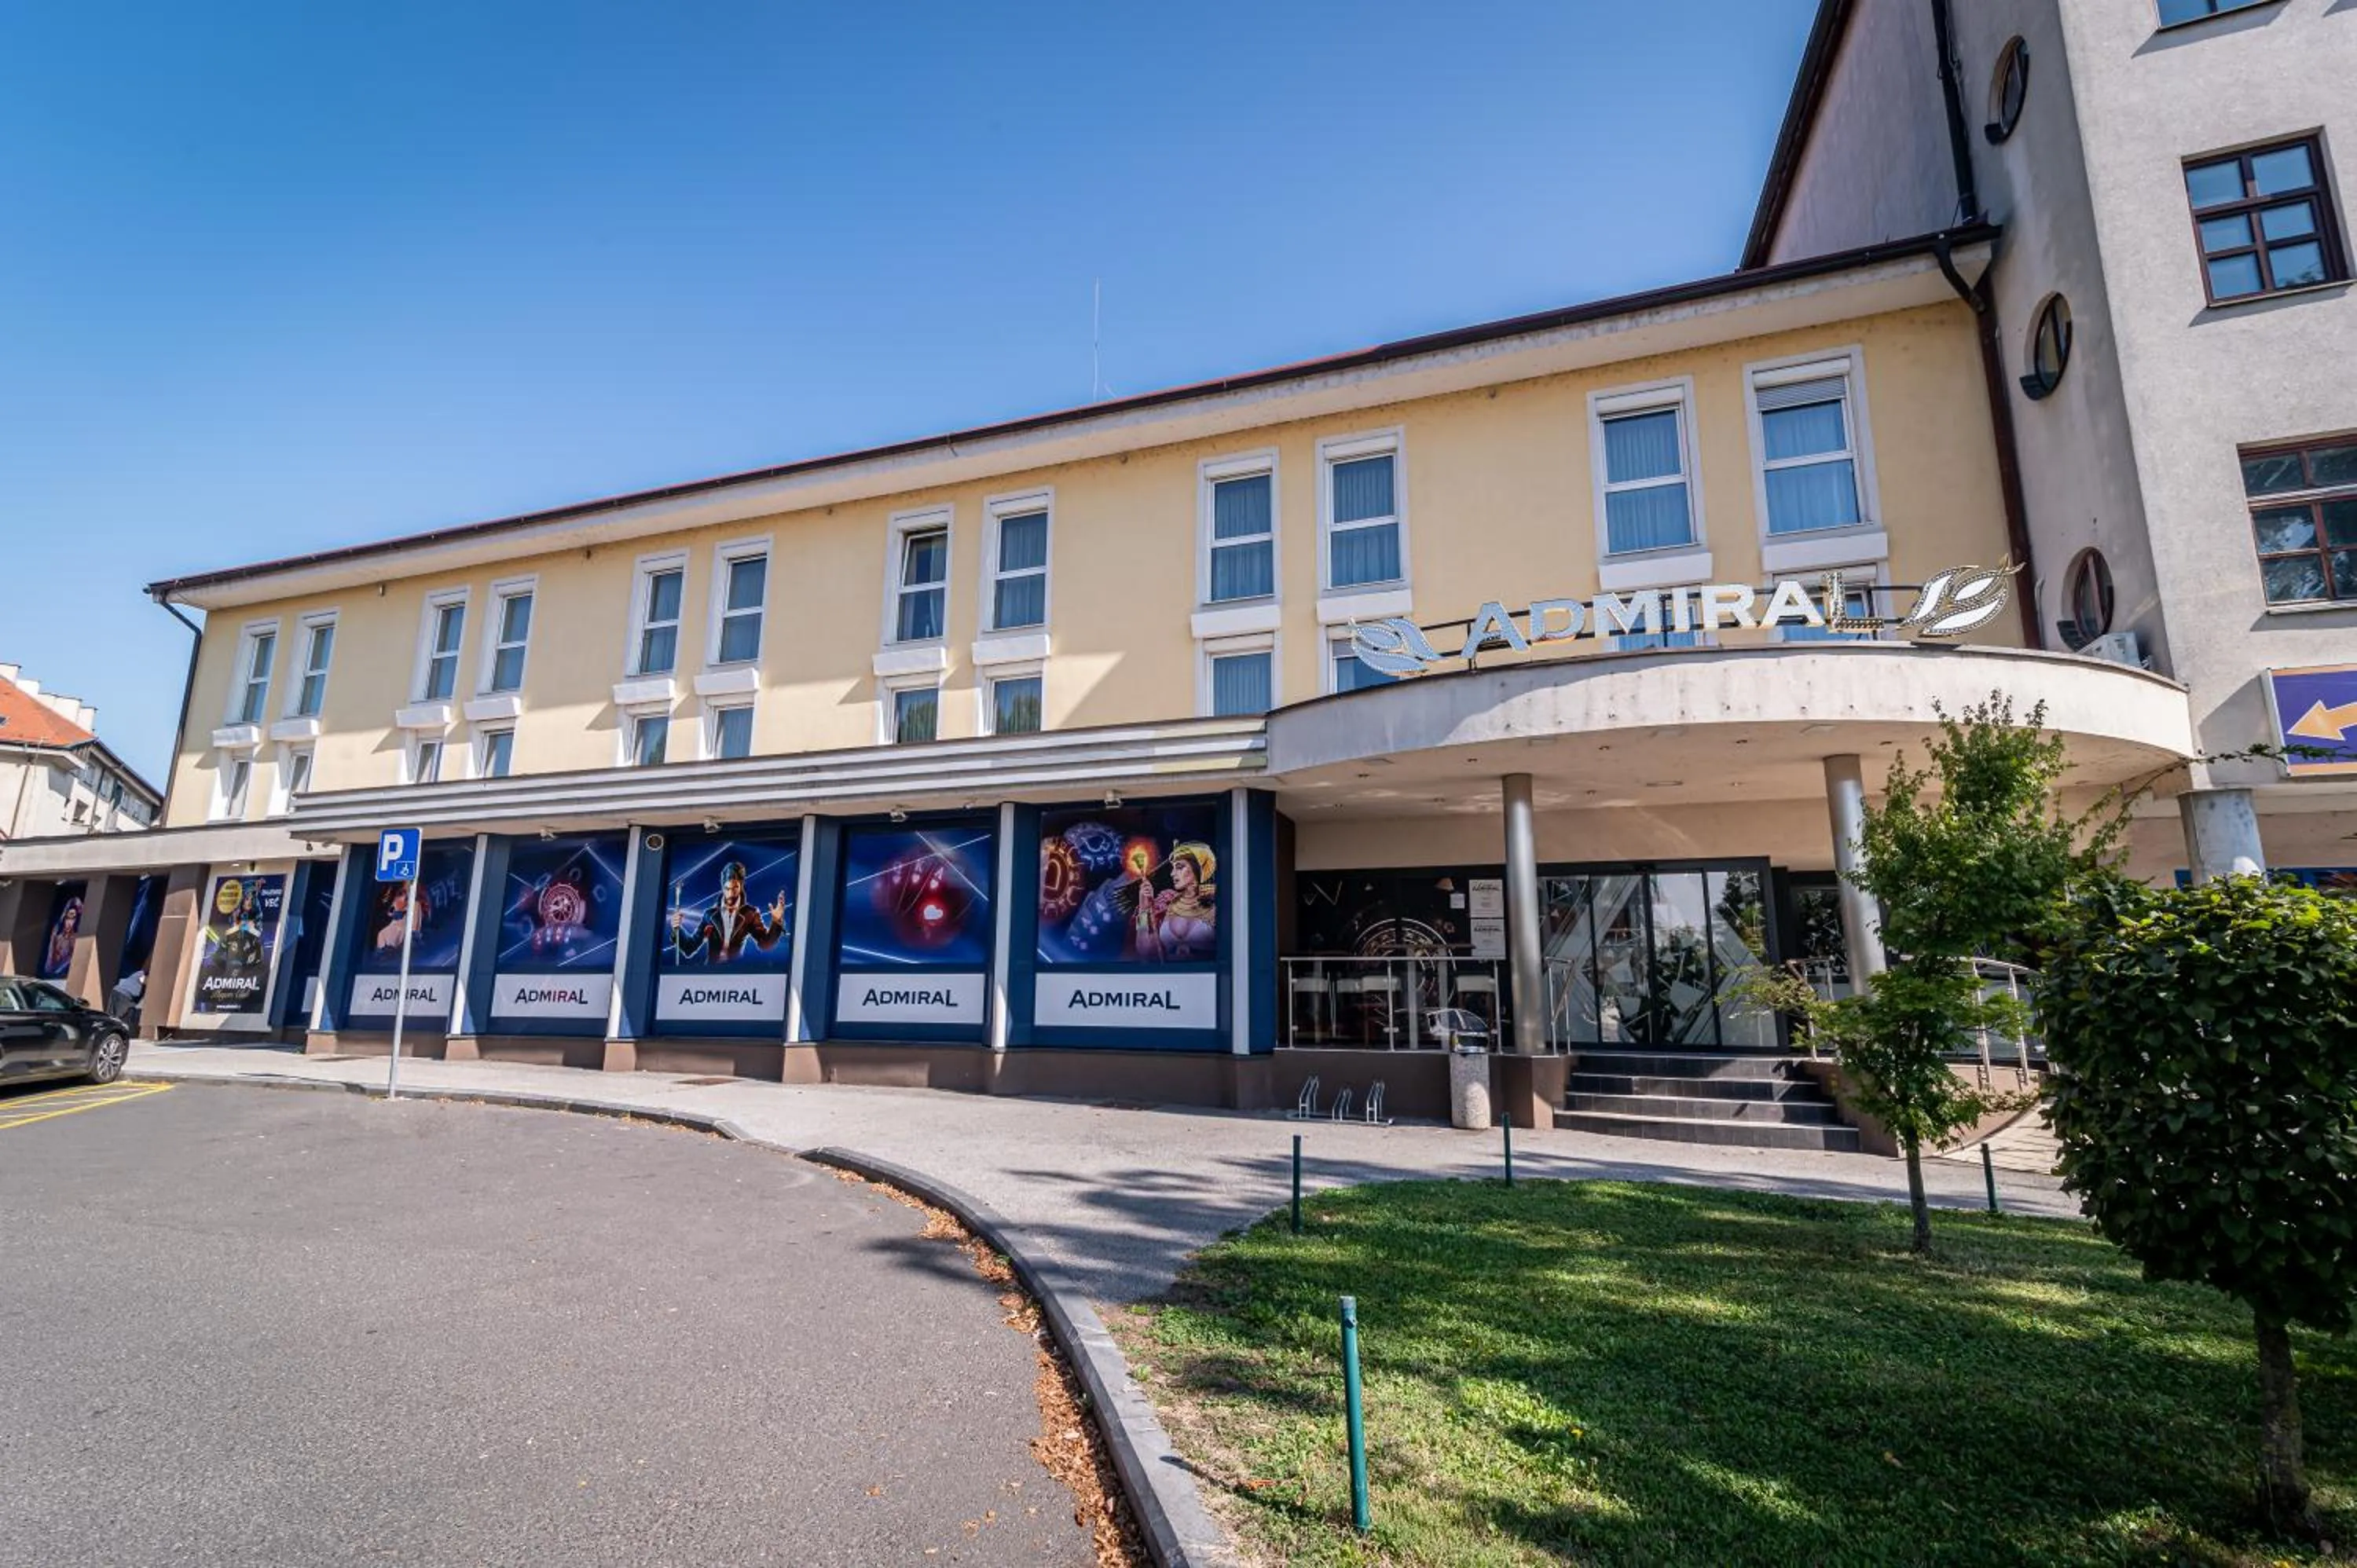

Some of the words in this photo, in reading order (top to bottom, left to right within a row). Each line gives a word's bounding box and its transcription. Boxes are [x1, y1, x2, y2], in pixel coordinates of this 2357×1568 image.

[1460, 568, 1886, 661] ADMIRAL
[380, 833, 404, 871] P
[202, 976, 260, 991] ADMIRAL
[515, 987, 588, 1005] ADMIRAL
[679, 987, 763, 1005] ADMIRAL
[862, 988, 958, 1007] ADMIRAL
[1068, 989, 1181, 1009] ADMIRAL
